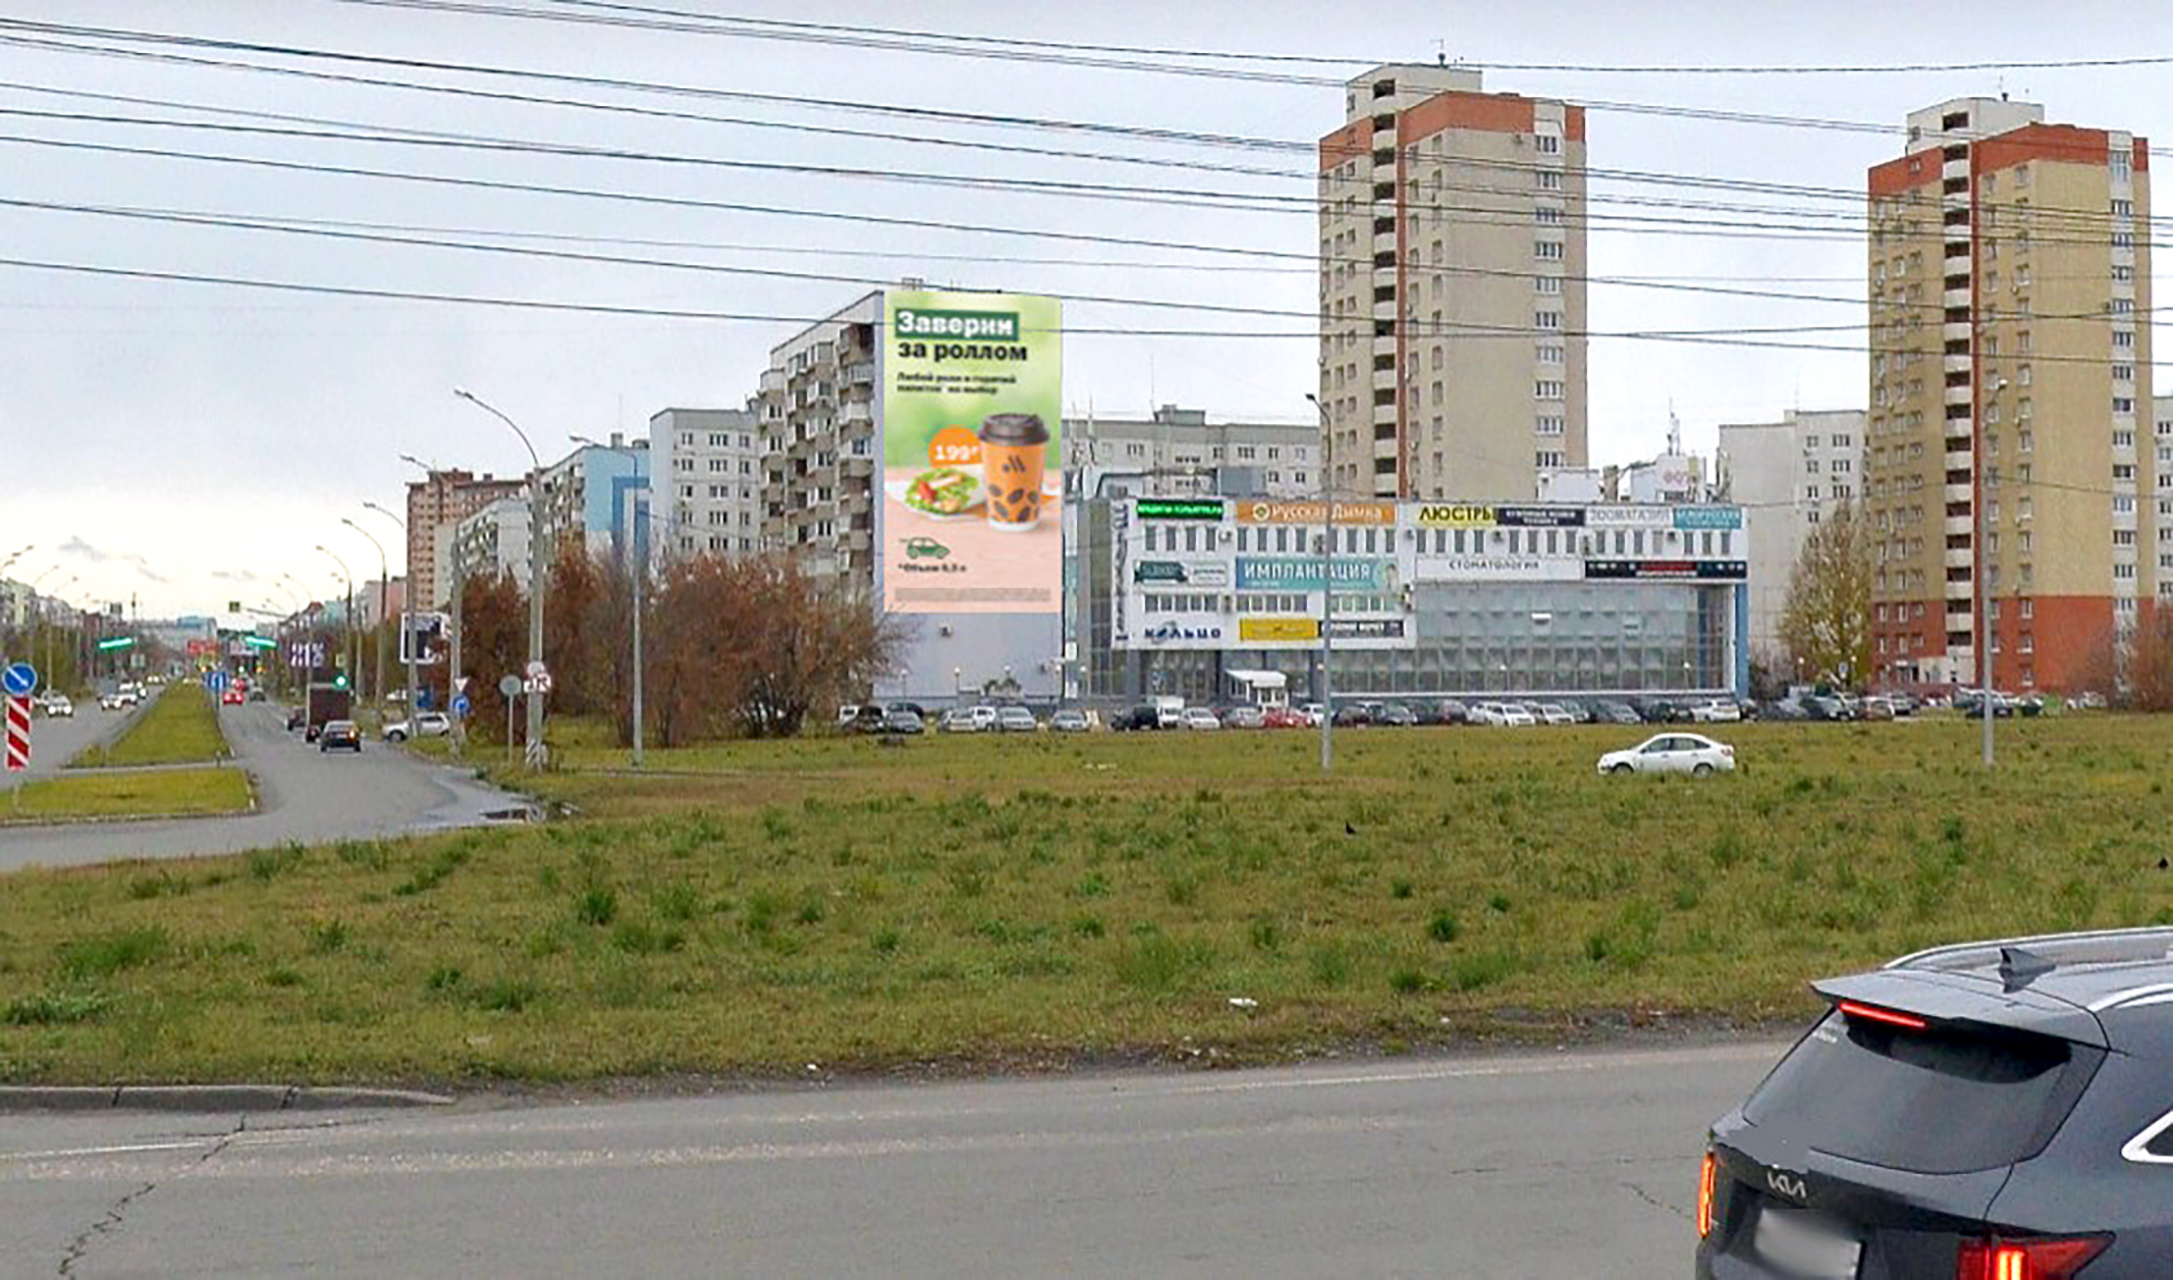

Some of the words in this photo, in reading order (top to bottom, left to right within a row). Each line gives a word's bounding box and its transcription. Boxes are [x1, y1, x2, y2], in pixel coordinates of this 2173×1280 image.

[898, 311, 1013, 337] Заверни
[898, 343, 927, 358] за
[934, 343, 1028, 362] роллом
[1331, 503, 1383, 520] Дымка
[1244, 563, 1371, 581] ИМПЛАНТАЦИЯ
[1448, 559, 1540, 571] СТОМАТОЛОГИЯ
